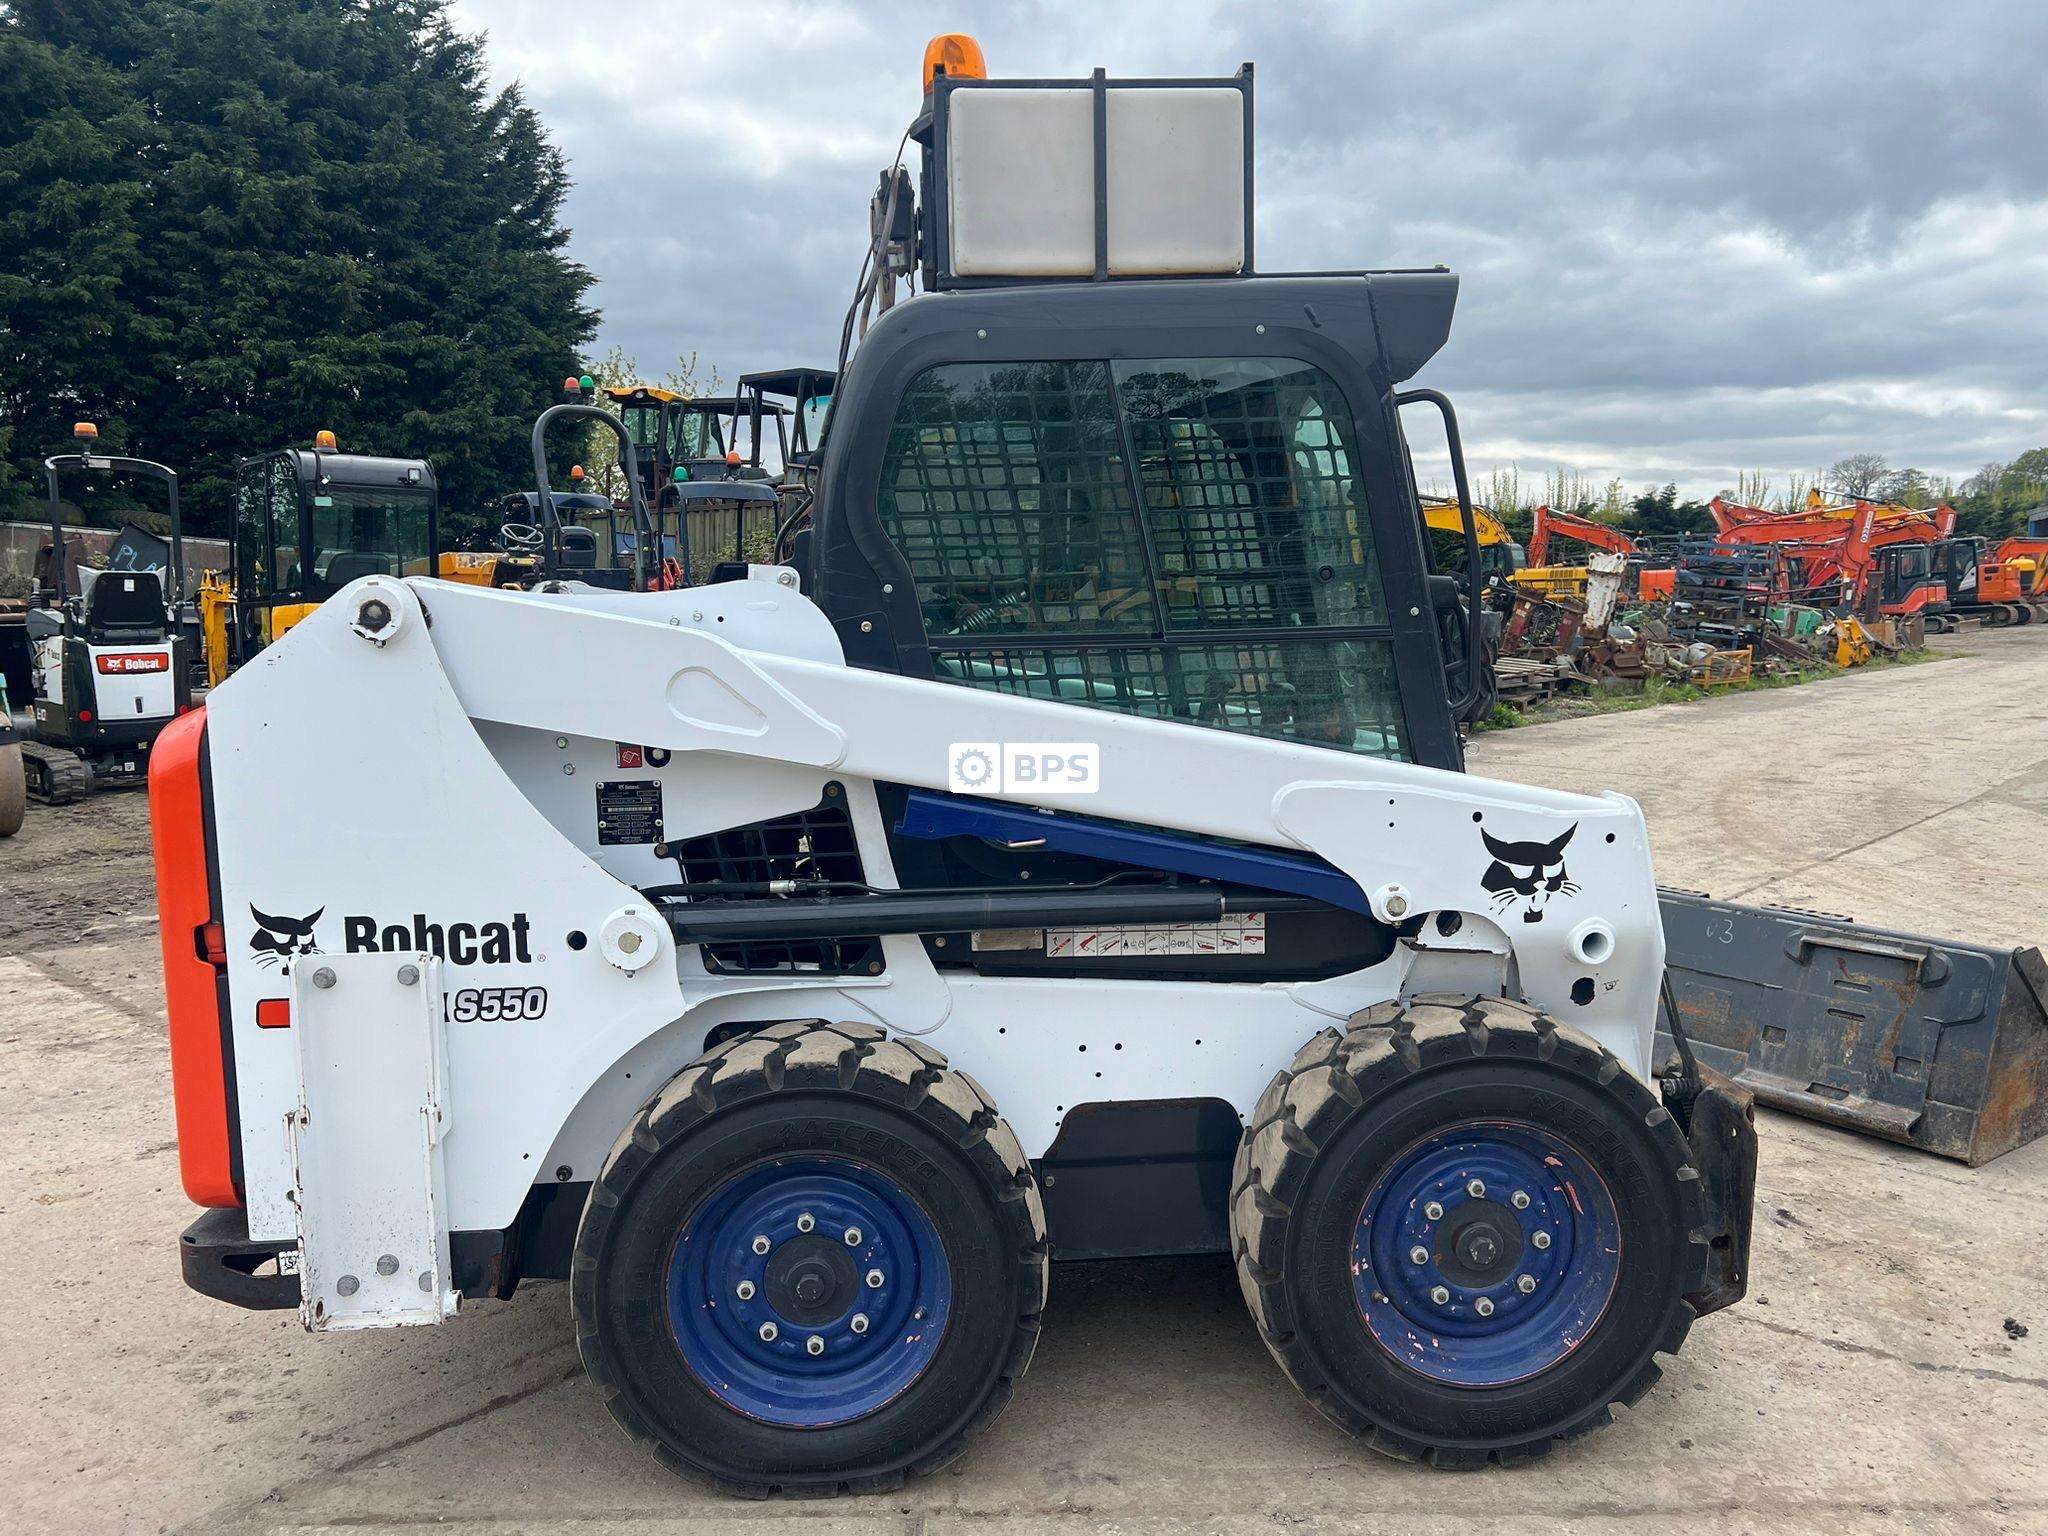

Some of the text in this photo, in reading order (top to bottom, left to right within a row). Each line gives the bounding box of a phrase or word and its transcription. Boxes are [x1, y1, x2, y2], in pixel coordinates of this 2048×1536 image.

[125, 658, 160, 670] Bobcat
[344, 913, 532, 966] Bobcat
[454, 986, 547, 1023] S550
[800, 1120, 938, 1179] ASCENSO
